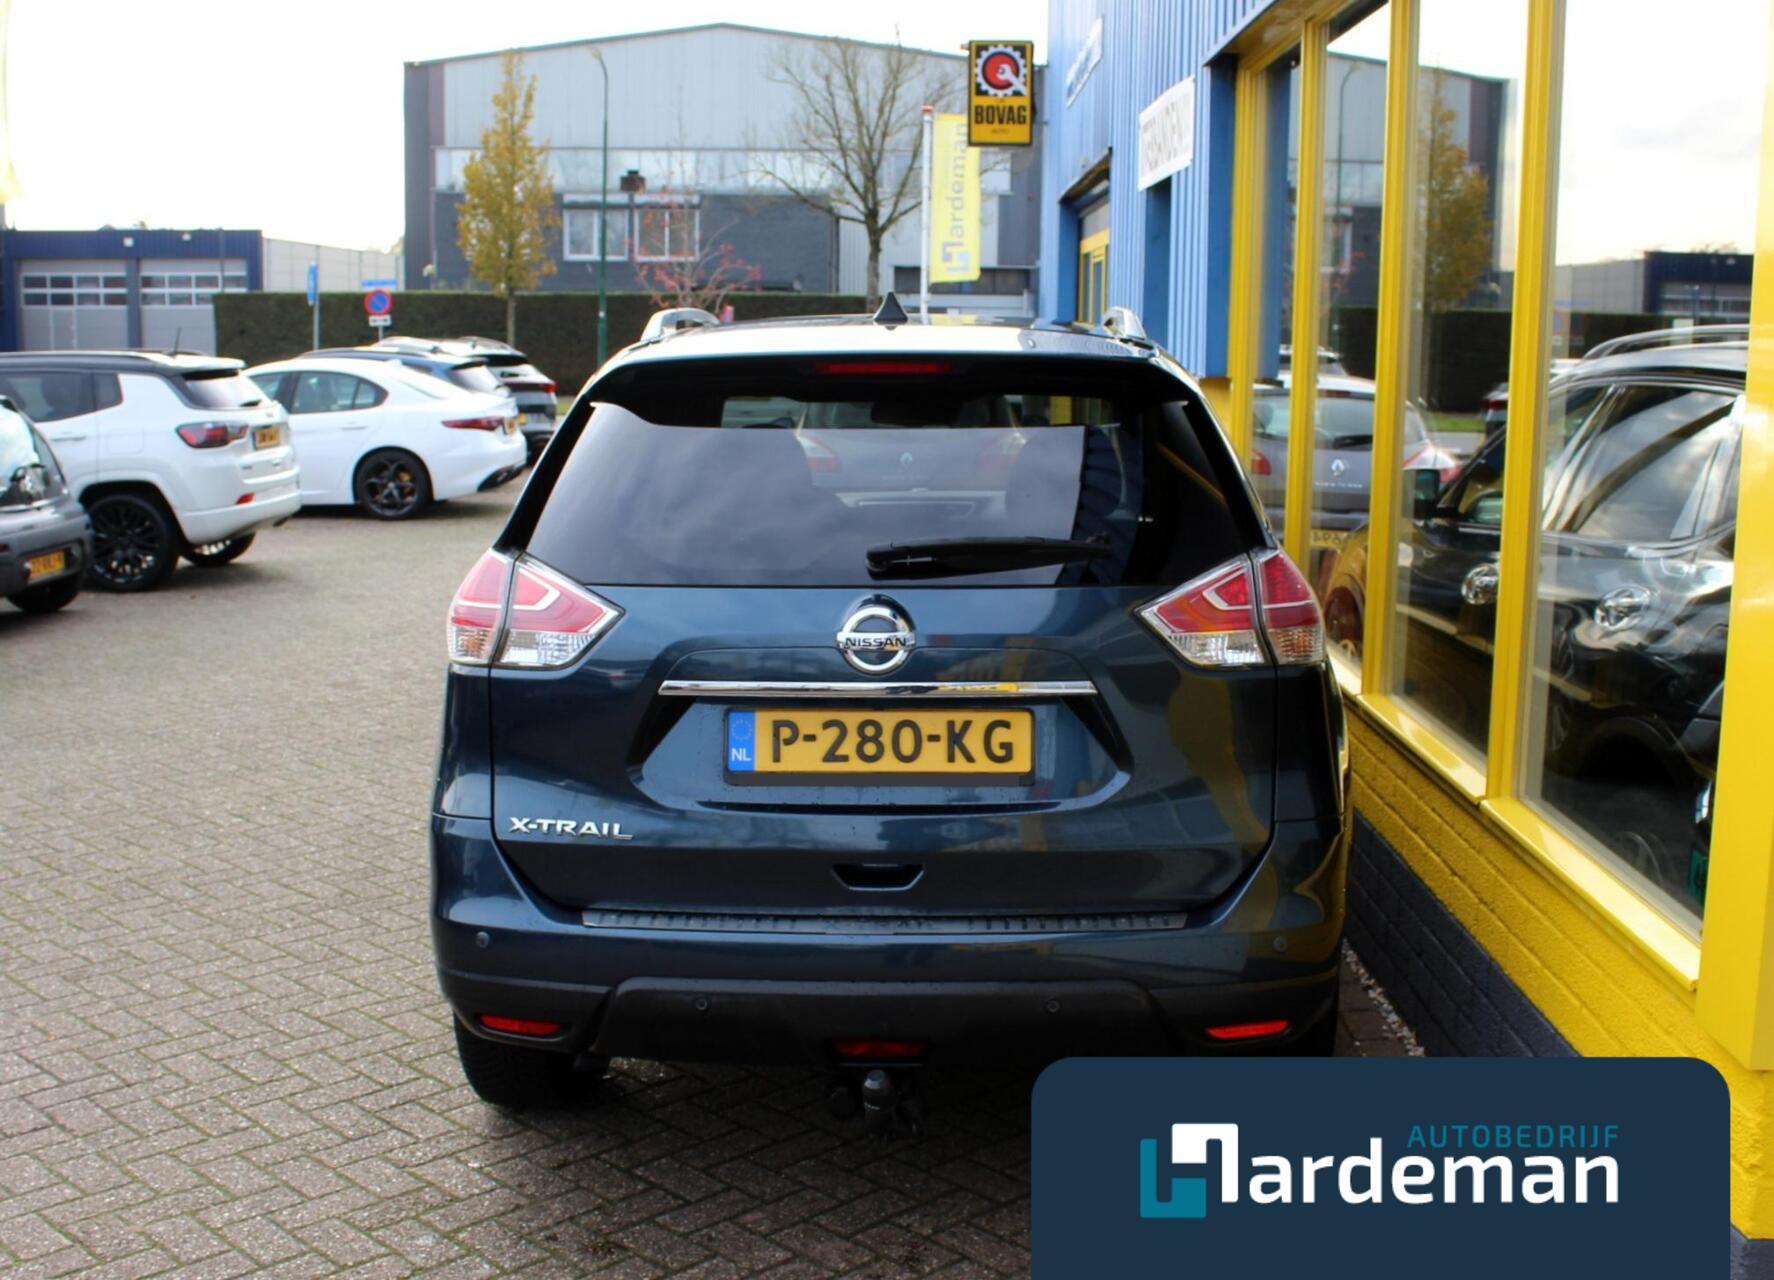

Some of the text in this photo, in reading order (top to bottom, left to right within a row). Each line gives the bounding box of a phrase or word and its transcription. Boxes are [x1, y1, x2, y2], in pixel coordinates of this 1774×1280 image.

[975, 105, 1026, 125] BOVAG
[845, 637, 906, 648] NISSAN
[771, 718, 1014, 764] P-280-KG
[731, 748, 751, 761] NL
[509, 817, 634, 840] X-TRAIL
